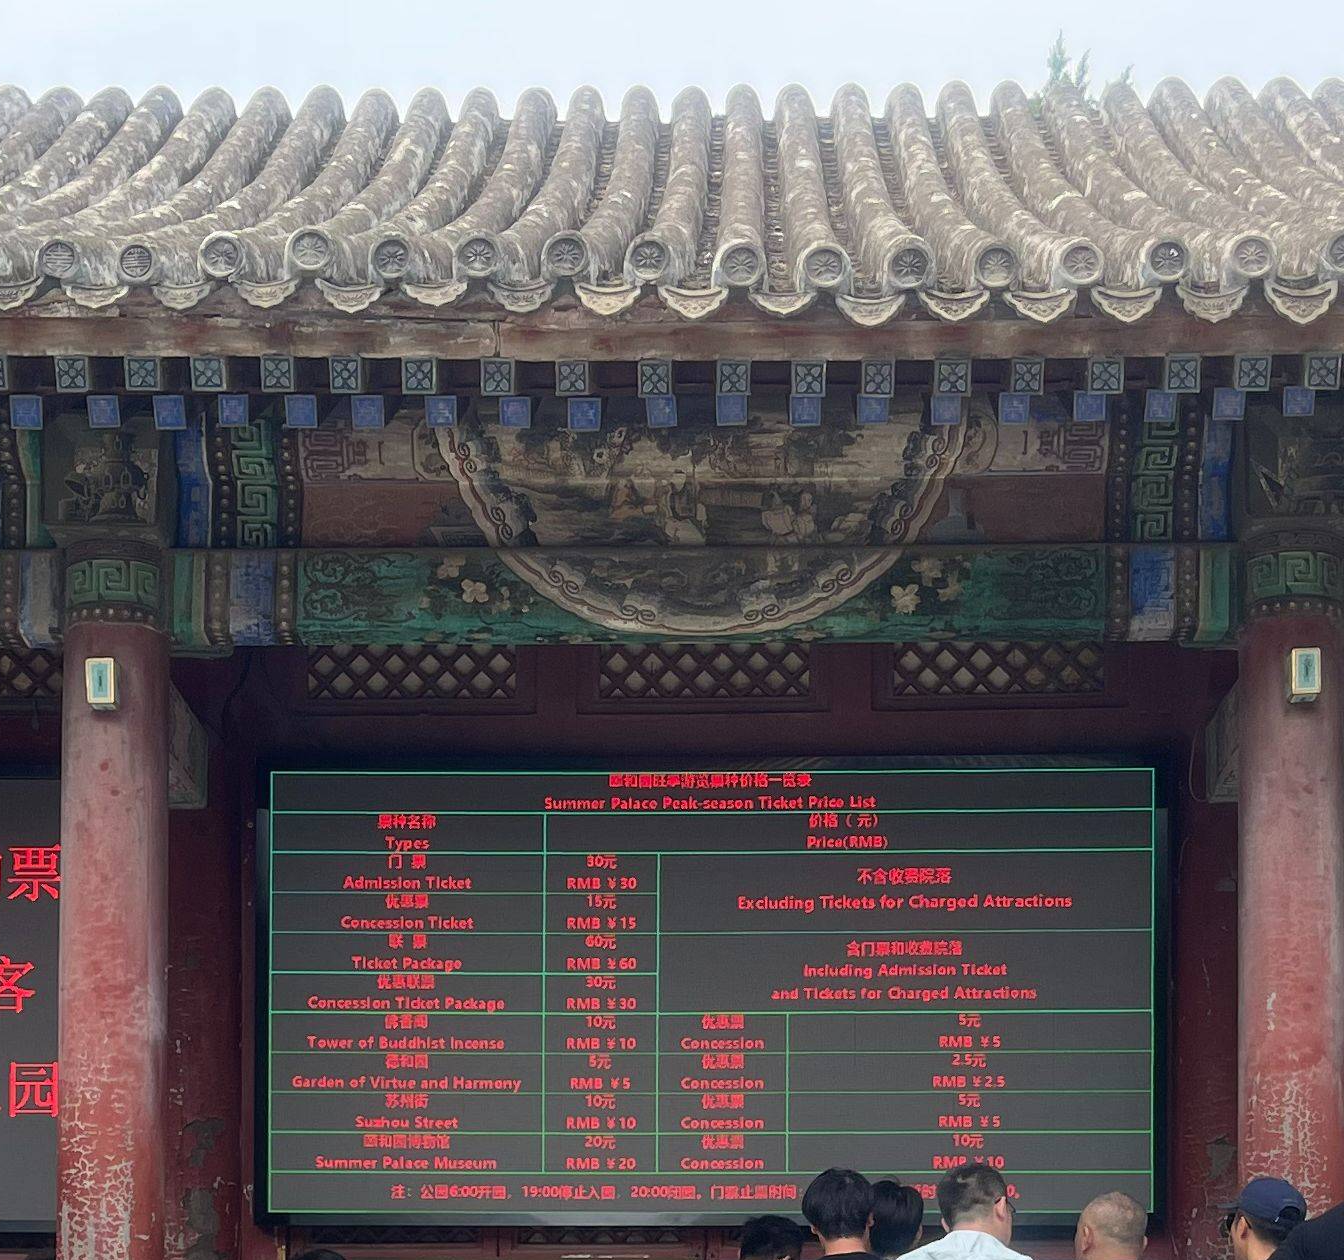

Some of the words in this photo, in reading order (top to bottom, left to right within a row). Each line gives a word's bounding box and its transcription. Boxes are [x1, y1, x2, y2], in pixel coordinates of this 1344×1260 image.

[545, 797, 605, 810] Summer
[611, 796, 657, 810] Palace
[662, 796, 754, 810] Peak-season
[758, 795, 803, 809] Ticket
[808, 796, 845, 809] Price
[849, 796, 876, 808] List
[386, 836, 429, 851] Types
[807, 835, 886, 848] Price(RMB)
[344, 876, 421, 889] Admission
[426, 876, 471, 889] Ticket
[567, 876, 601, 889] RMB
[738, 896, 815, 912] Excluding
[821, 896, 876, 909] Tickets
[880, 895, 903, 909] for
[909, 895, 979, 911] Charged
[984, 895, 1072, 908] Attractions
[341, 918, 424, 929] Concession
[428, 916, 473, 929] Ticket
[567, 916, 601, 929] RMB
[352, 955, 398, 969] Ticket
[402, 956, 461, 972] Package
[567, 957, 601, 970] RMB
[803, 965, 873, 979] Including
[878, 964, 956, 976] Admission
[962, 963, 1007, 976] Ticket
[771, 989, 799, 1000] and
[804, 987, 856, 999] Tickets
[860, 988, 881, 999] for
[888, 986, 949, 1002] Charged
[954, 987, 1036, 999] Attractions
[308, 996, 390, 1009] Concession
[396, 995, 440, 1009] Ticket
[445, 996, 504, 1011] Package
[567, 997, 600, 1010] RMB
[308, 1036, 352, 1048] Tower
[359, 1036, 374, 1048] of
[379, 1036, 445, 1049] Buddhist
[451, 1039, 504, 1049] Incense
[566, 1037, 600, 1049] RMB
[681, 1038, 763, 1050] Concession
[939, 1035, 972, 1048] RMB
[292, 1077, 344, 1088] Garden
[350, 1077, 365, 1088] of
[371, 1078, 416, 1090] Virtue
[421, 1079, 448, 1089] and
[453, 1077, 520, 1091] Harmony
[570, 1077, 603, 1090] RMB
[681, 1078, 764, 1090] Concession
[933, 1076, 966, 1088] RMB
[356, 1116, 410, 1129] Suzhou
[414, 1117, 458, 1129] Street
[566, 1116, 600, 1129] RMB
[681, 1117, 764, 1129] Concession
[939, 1116, 972, 1128] RMB
[316, 1157, 376, 1168] Summer
[383, 1156, 428, 1169] Palace
[433, 1157, 496, 1169] Museum
[566, 1157, 600, 1169] RMB
[681, 1159, 764, 1169] Concession
